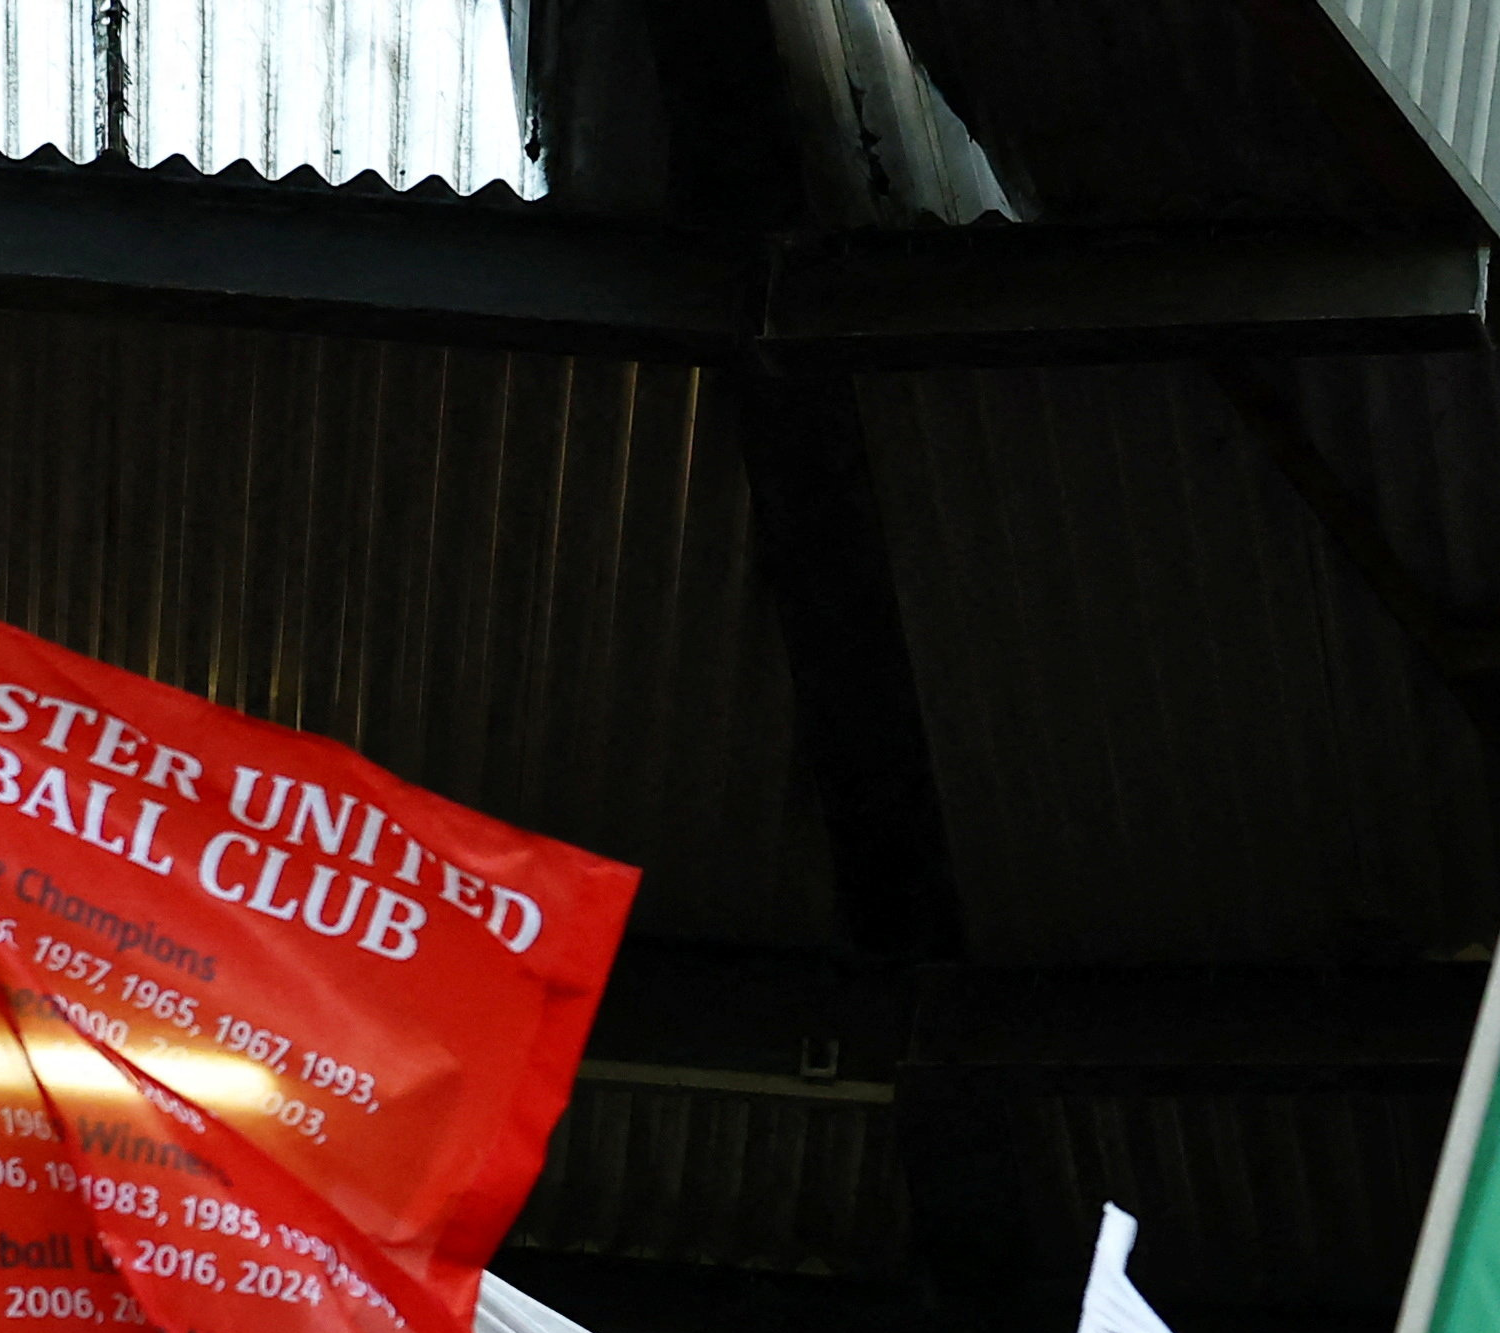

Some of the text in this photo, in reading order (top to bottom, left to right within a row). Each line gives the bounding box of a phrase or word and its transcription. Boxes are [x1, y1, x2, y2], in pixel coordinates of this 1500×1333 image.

[199, 830, 428, 960] CLUB
[229, 765, 543, 954] UNITED
[15, 867, 219, 983] Champions
[32, 934, 113, 994] 1957,
[120, 973, 202, 1038] 1965,
[214, 1014, 292, 1077] 1967,
[302, 1050, 380, 1113] 1993,
[80, 1174, 169, 1228] 1983,
[181, 1195, 272, 1248] 1985,
[4, 1286, 105, 1324] 2006,
[133, 1239, 226, 1293] 2016,
[235, 1260, 324, 1306] 2024
